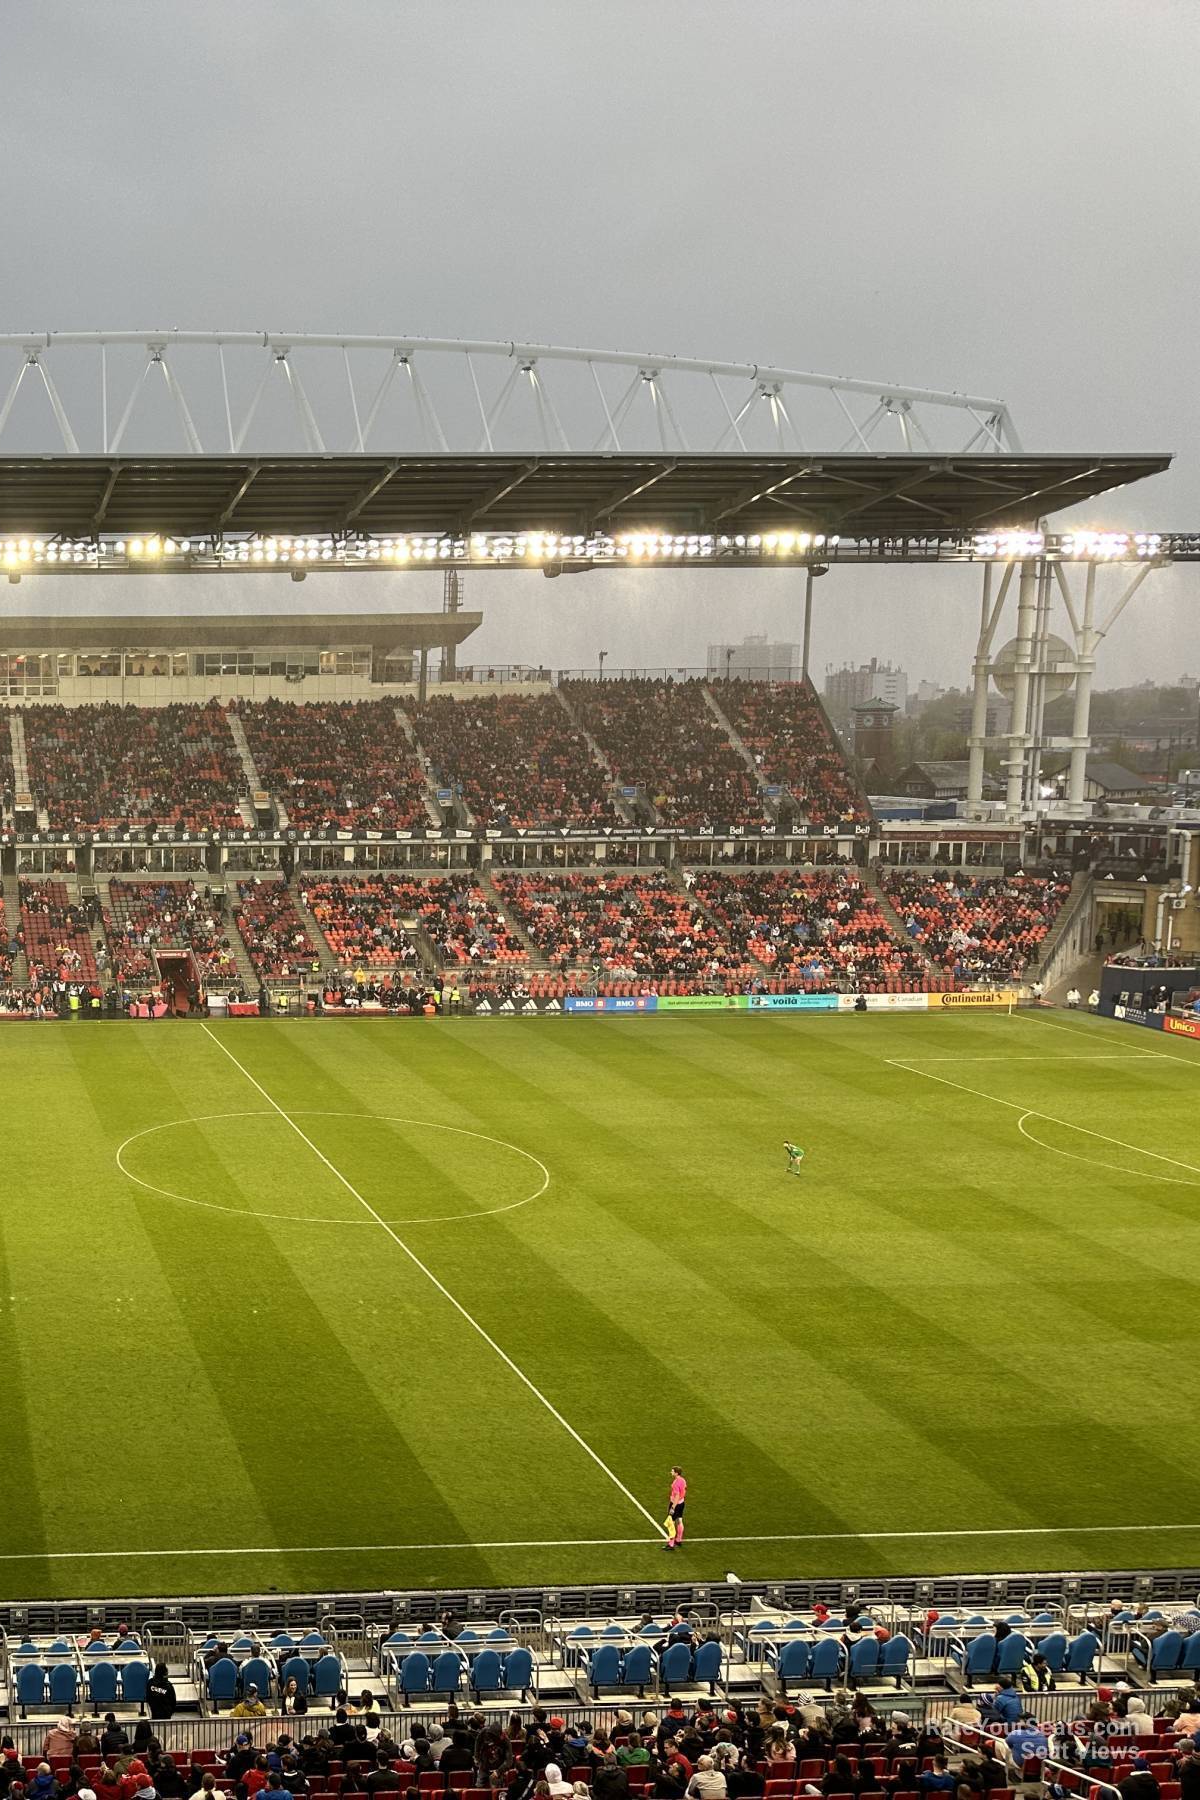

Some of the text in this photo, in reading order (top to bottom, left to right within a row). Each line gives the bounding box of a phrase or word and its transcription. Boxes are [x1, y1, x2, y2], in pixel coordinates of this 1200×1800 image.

[699, 826, 714, 835] Bell
[729, 825, 744, 834] Bell
[761, 825, 776, 834] Bell
[792, 825, 807, 834] Bell
[823, 825, 839, 834] Bell
[855, 825, 870, 834] Bell
[941, 992, 994, 1005] Continental
[1169, 1018, 1196, 1034] Unico
